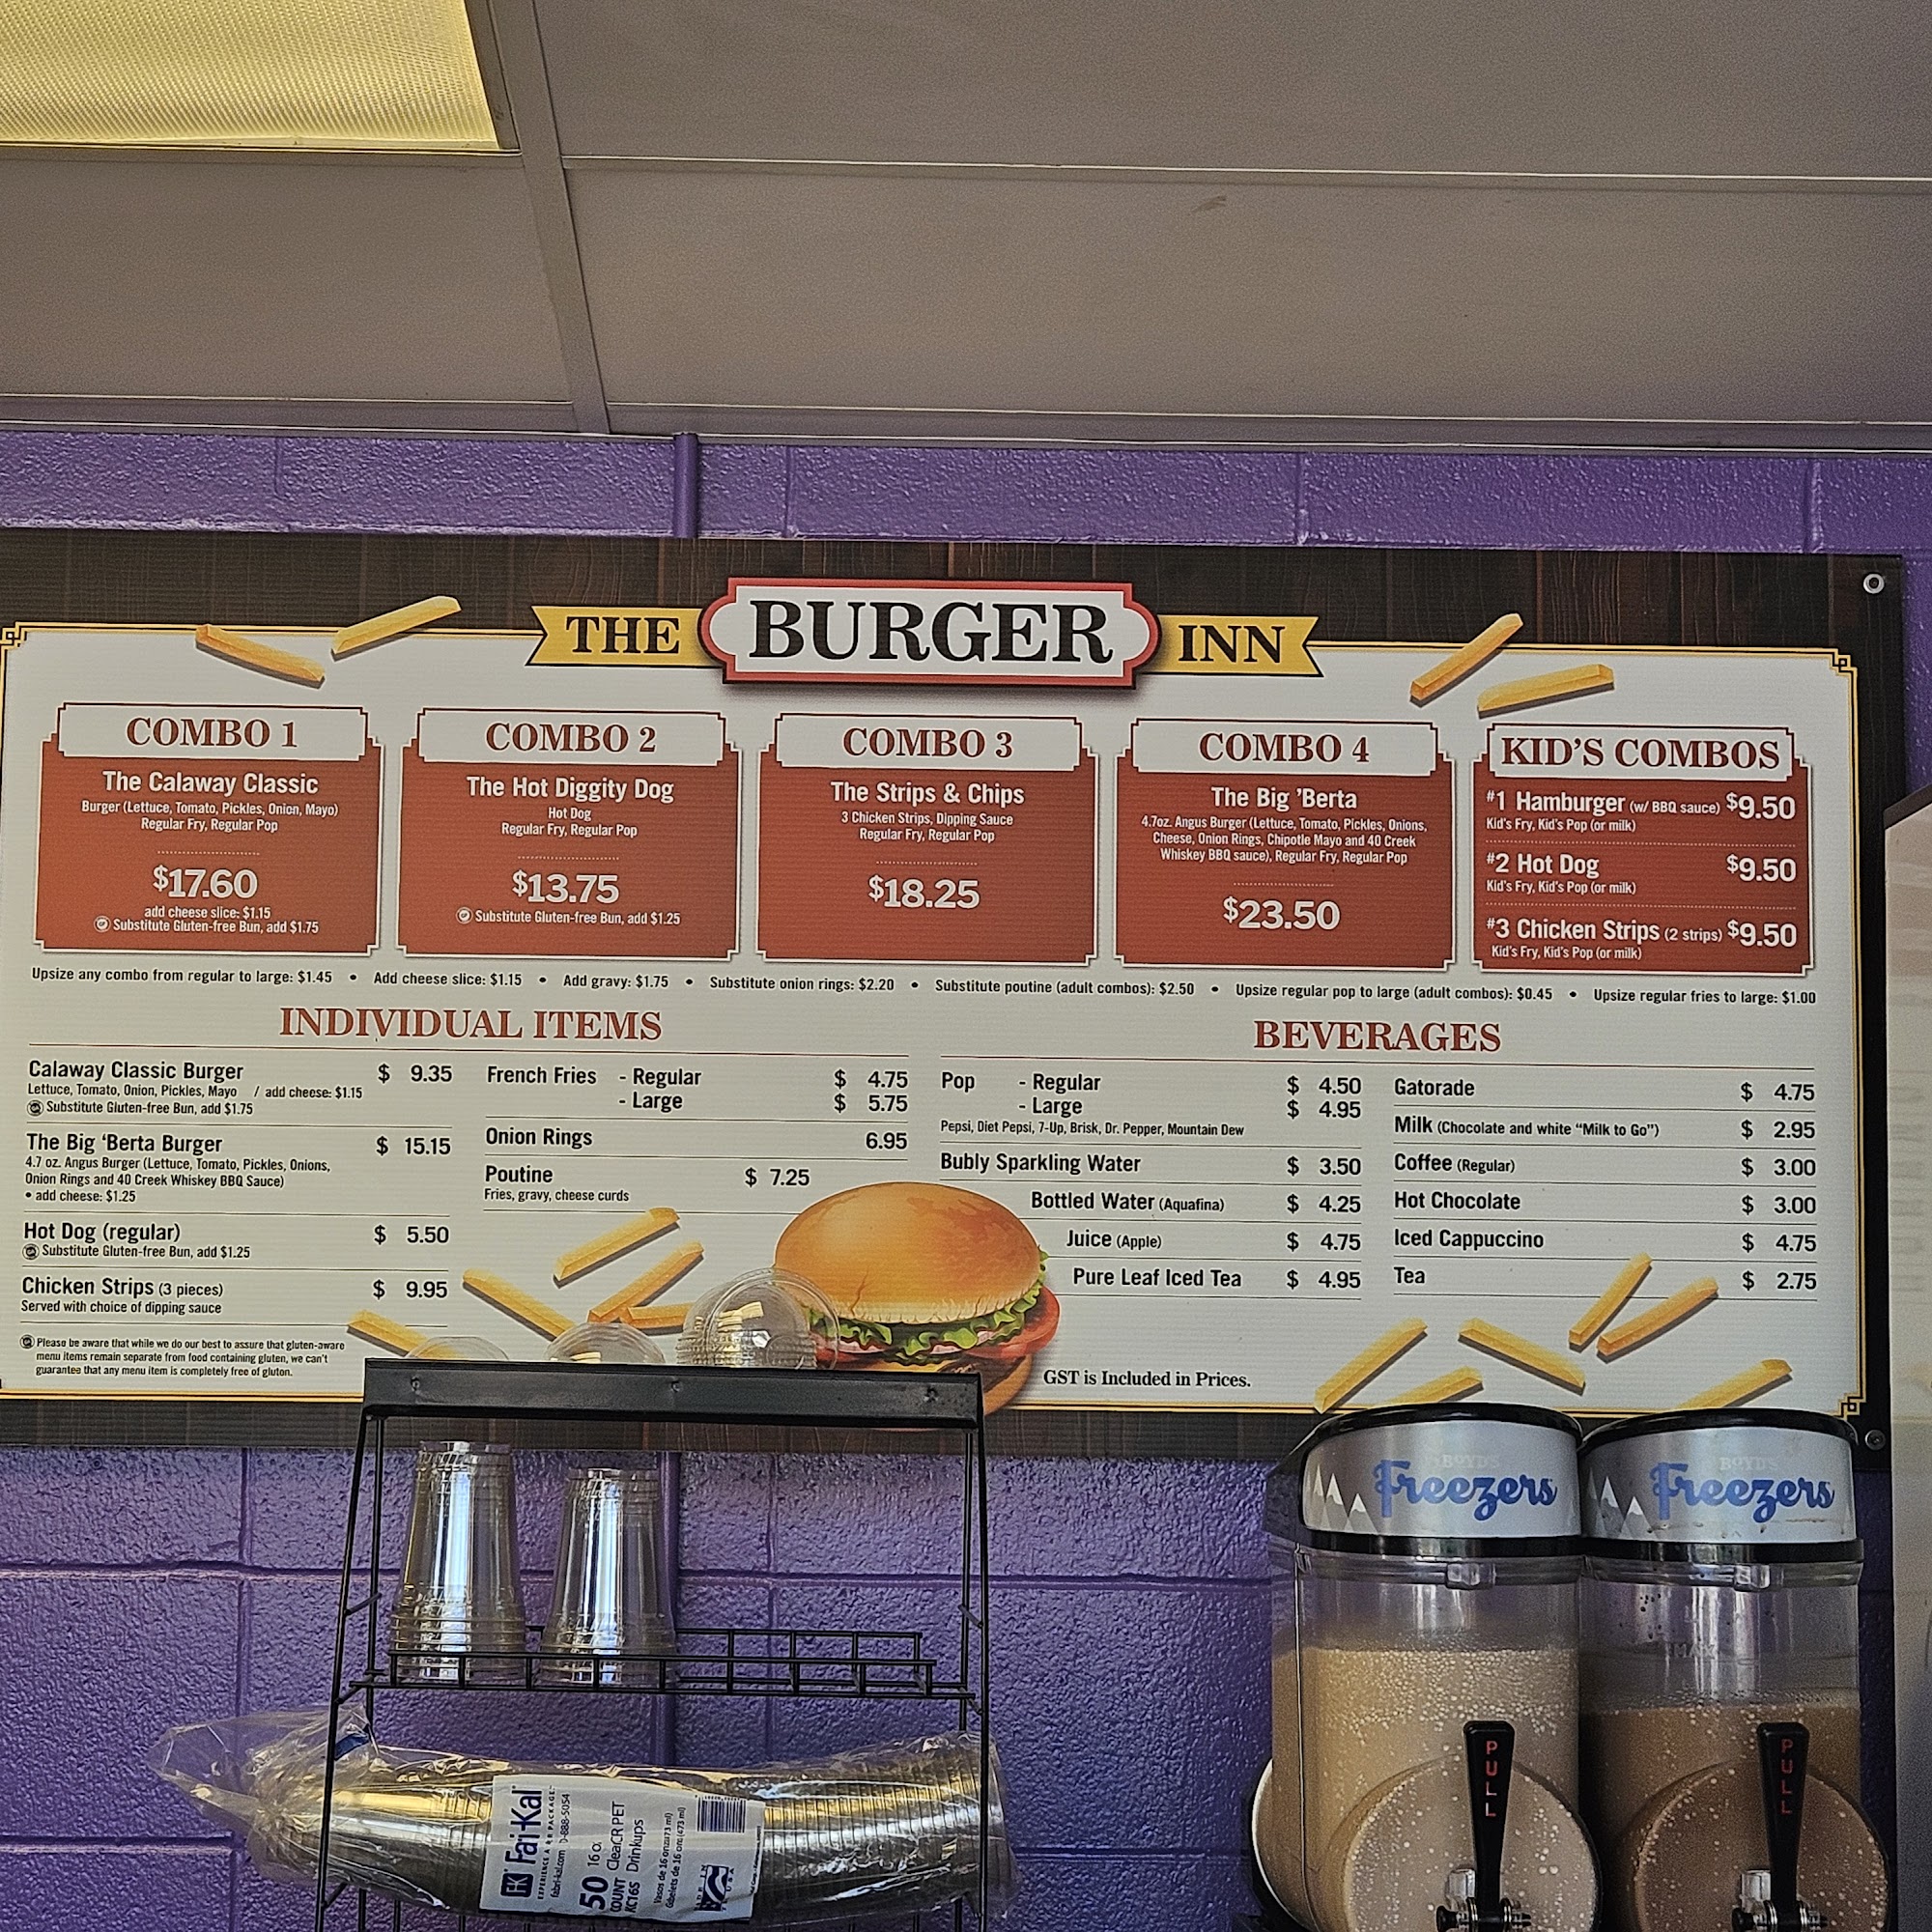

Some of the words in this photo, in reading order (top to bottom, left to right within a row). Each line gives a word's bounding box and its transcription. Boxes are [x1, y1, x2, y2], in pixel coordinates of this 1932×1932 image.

[565, 615, 680, 655] THE
[748, 599, 1114, 665] BURGER
[1177, 624, 1286, 664] INN
[126, 716, 270, 748] COMBO
[281, 721, 298, 748] 1
[485, 722, 629, 753] COMBO
[639, 725, 656, 753] 2
[842, 726, 985, 758] COMBO
[994, 730, 1012, 758] 3
[1199, 731, 1342, 763] COMBO
[1351, 735, 1370, 763] 4
[1500, 736, 1605, 767] KID'S
[1614, 738, 1780, 770] COMBOS
[101, 770, 142, 791] The
[148, 770, 237, 798] Calaway
[242, 772, 319, 794] Classic
[466, 775, 505, 797] The
[512, 776, 549, 798] Hot
[554, 775, 628, 803] Diggity
[634, 778, 674, 804] Dog
[829, 781, 869, 803] The
[875, 781, 936, 808] Strips
[942, 781, 961, 804] &
[967, 781, 1025, 809] Chips
[80, 799, 122, 815] Burger
[122, 799, 173, 815] (Lettuce,
[174, 800, 219, 815] Tomato,
[221, 801, 266, 816] Pickles,
[268, 802, 302, 817] Onion,
[304, 802, 339, 818] Mayo)
[1209, 785, 1249, 808] The
[1256, 785, 1291, 812] Big
[1295, 786, 1357, 810] 'Berta
[1486, 789, 1505, 811] #1
[1516, 790, 1627, 817] Hamburger
[1629, 799, 1650, 814] (w/
[1651, 800, 1678, 814] BBQ
[1679, 801, 1720, 815] sauce)
[1725, 791, 1796, 820] $9.50
[840, 810, 849, 823] 3
[851, 810, 895, 824] Chicken
[896, 810, 934, 827] Strips,
[935, 811, 978, 828] Dipping
[979, 811, 1014, 826] Sauce
[1486, 851, 1510, 873] #2
[1517, 852, 1553, 874] Hot
[1559, 853, 1600, 879] Dog
[1725, 853, 1797, 882] $9.50
[152, 864, 258, 898] $17.60
[511, 868, 619, 904] $13.75
[867, 873, 980, 909] $18.25
[1222, 895, 1341, 930] $23.50
[1486, 917, 1510, 939] #3
[1517, 917, 1597, 940] Chicken
[1602, 919, 1661, 946] Strips
[1663, 926, 1679, 942] (2
[1681, 926, 1723, 943] strips)
[1726, 918, 1797, 948] $9.50
[31, 966, 74, 982] Upsize
[77, 970, 101, 982] any
[104, 967, 149, 981] combo
[152, 968, 184, 981] from
[186, 968, 236, 984] regular
[238, 970, 252, 982] to
[255, 969, 294, 985] large:
[297, 969, 332, 984] $1.45
[1593, 987, 1636, 1004] Upsize
[1639, 988, 1688, 1005] regular
[1690, 989, 1720, 1003] fries
[1722, 990, 1737, 1004] to
[1740, 990, 1778, 1007] large:
[1780, 989, 1816, 1006] $1.00
[278, 1007, 524, 1039] INDIVIDUAL
[532, 1009, 662, 1041] ITEMS
[1253, 1019, 1501, 1053] BEVERAGES
[28, 1059, 105, 1082] Calaway
[110, 1060, 177, 1079] Classic
[183, 1061, 244, 1084] Burger
[410, 1064, 453, 1083] 9.35
[487, 1065, 547, 1084] French
[554, 1065, 597, 1085] Fries
[632, 1066, 702, 1090] Regular
[867, 1069, 908, 1089] 4.75
[941, 1070, 976, 1094] Pop
[1032, 1072, 1101, 1094] Regular
[1318, 1076, 1362, 1094] 4.50
[1394, 1076, 1475, 1096] Gatorade
[1773, 1082, 1815, 1101] 4.75
[1394, 1114, 1434, 1133] Milk
[1773, 1120, 1816, 1139] 2.95
[25, 1132, 60, 1151] The
[66, 1132, 96, 1155] Big
[100, 1132, 155, 1151] 'Berta
[161, 1133, 223, 1156] Burger
[404, 1136, 451, 1155] 15.15
[485, 1125, 536, 1145] Onion
[542, 1126, 593, 1151] Rings
[865, 1131, 908, 1151] 6.95
[484, 1164, 554, 1183] Poutine
[940, 1151, 990, 1175] Bubly
[995, 1151, 1082, 1176] Sparkling
[1086, 1153, 1142, 1173] Water
[1319, 1156, 1361, 1176] 3.50
[1394, 1151, 1453, 1172] Coffee
[1456, 1157, 1516, 1175] (Regular)
[1773, 1157, 1816, 1177] 3.00
[769, 1167, 810, 1186] 7.25
[483, 1187, 516, 1202] Fries,
[517, 1190, 553, 1203] gravy,
[554, 1188, 595, 1202] cheese
[597, 1188, 630, 1202] curds
[1394, 1190, 1426, 1208] Hot
[1431, 1190, 1521, 1210] Chocolate
[1773, 1195, 1817, 1214] 3.00
[23, 1221, 56, 1239] Hot
[61, 1221, 97, 1244] Dog
[102, 1221, 181, 1244] (regular)
[406, 1225, 449, 1244] 5.50
[1394, 1227, 1433, 1247] Iced
[1438, 1228, 1545, 1251] Cappuccino
[1775, 1234, 1817, 1253] 4.75
[1392, 1265, 1426, 1284] Tea
[1776, 1271, 1817, 1291] 2.75
[21, 1275, 95, 1295] Chicken
[100, 1276, 155, 1299] Strips
[157, 1281, 172, 1297] (3
[176, 1281, 224, 1299] pieces)
[405, 1280, 448, 1299] 9.95
[20, 1298, 61, 1313] Served
[62, 1299, 87, 1313] with
[89, 1299, 128, 1313] choice
[129, 1299, 143, 1313] of
[144, 1300, 186, 1316] dipping
[187, 1303, 222, 1314] sauce
[1042, 1368, 1080, 1385] GST
[1083, 1368, 1097, 1386] is
[1100, 1369, 1172, 1386] Included
[1175, 1370, 1191, 1386] in
[1195, 1371, 1251, 1388] Prices.
[1373, 1459, 1558, 1521] Freezers
[1649, 1462, 1835, 1523] Freezers
[1485, 1740, 1498, 1817] PULL
[1780, 1738, 1794, 1815] PULL
[611, 1801, 625, 1826] PET
[586, 1854, 601, 1867] 16
[579, 1876, 609, 1911] 50
[610, 1877, 626, 1913] COUNT
